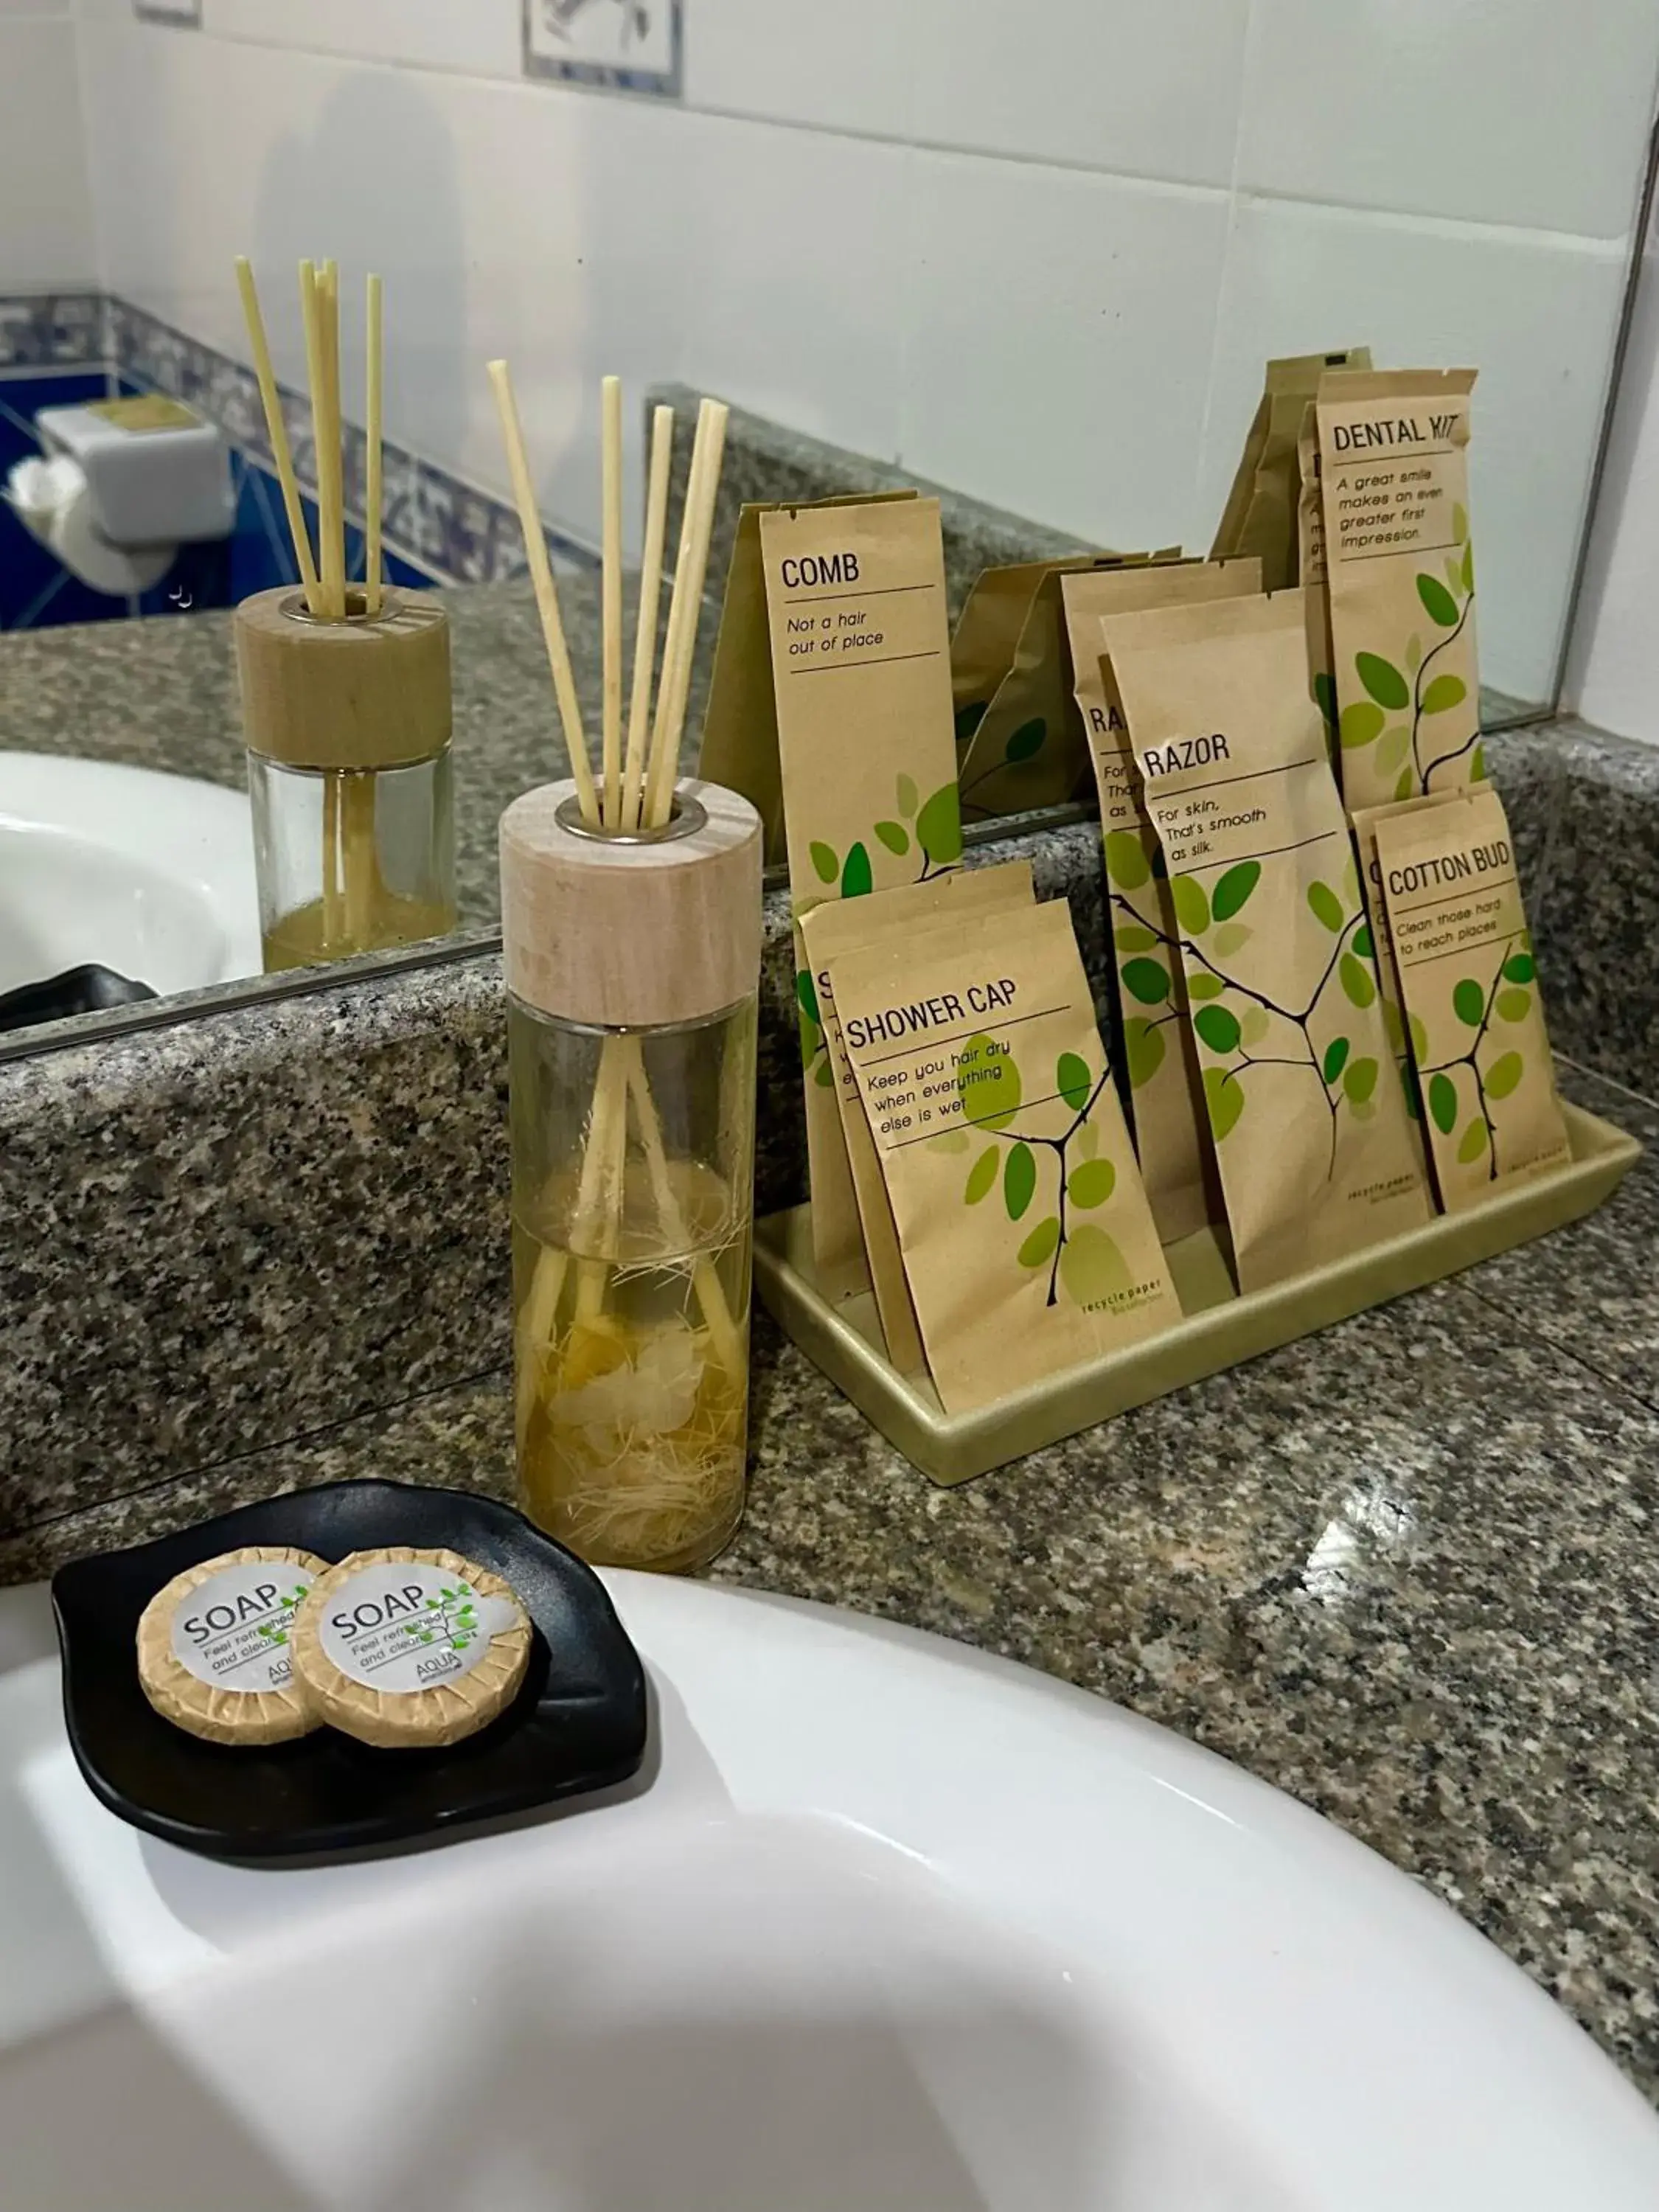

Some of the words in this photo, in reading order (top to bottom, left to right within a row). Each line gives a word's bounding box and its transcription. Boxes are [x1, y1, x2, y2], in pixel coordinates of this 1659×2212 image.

[1334, 419, 1426, 451] DENTAL
[1429, 414, 1458, 440] KIT
[1336, 478, 1348, 491] A
[1354, 473, 1394, 491] great
[1400, 469, 1431, 482] smile
[1338, 495, 1389, 510] makes
[1396, 492, 1413, 503] an
[1417, 488, 1443, 500] even
[1340, 512, 1396, 532] greater
[1402, 507, 1425, 521] first
[782, 553, 860, 588] COMB
[787, 618, 815, 633] Not
[821, 618, 831, 629] a
[838, 611, 866, 625] hair
[789, 641, 814, 655] out
[821, 636, 838, 651] of
[843, 632, 883, 650] place
[1144, 734, 1231, 776] RAZOR
[1104, 767, 1127, 779] For
[1110, 806, 1127, 818] as
[1157, 808, 1179, 823] For
[1185, 800, 1219, 816] skin,
[1166, 823, 1203, 841] That's
[1210, 808, 1267, 831] smooth
[1172, 849, 1186, 861] as
[1389, 852, 1472, 896] COTTON
[1472, 841, 1510, 872] BUD
[1397, 919, 1432, 937] Clean
[1437, 908, 1472, 925] those
[1475, 898, 1501, 915] hard
[1401, 943, 1413, 955] to
[1418, 931, 1453, 950] reach
[1458, 920, 1497, 941] places
[847, 994, 966, 1048] SHOWER
[967, 978, 1017, 1013] CAP
[867, 1071, 908, 1091] Keep
[915, 1060, 945, 1080] you
[950, 1048, 980, 1067] hair
[986, 1040, 1011, 1057] dry
[874, 1091, 916, 1113] when
[922, 1065, 1002, 1098] everything
[880, 1116, 912, 1133] else
[919, 1108, 931, 1123] is
[939, 1097, 967, 1116] wet
[1082, 1293, 1125, 1314] recycle
[1127, 1279, 1161, 1298] paper
[184, 1584, 277, 1644] SOAP
[332, 1585, 424, 1638] SOAP
[204, 1639, 232, 1659] Feel
[351, 1636, 380, 1655] Feel
[360, 1649, 386, 1668] and
[212, 1652, 237, 1670] and
[416, 1652, 462, 1678] AQUA
